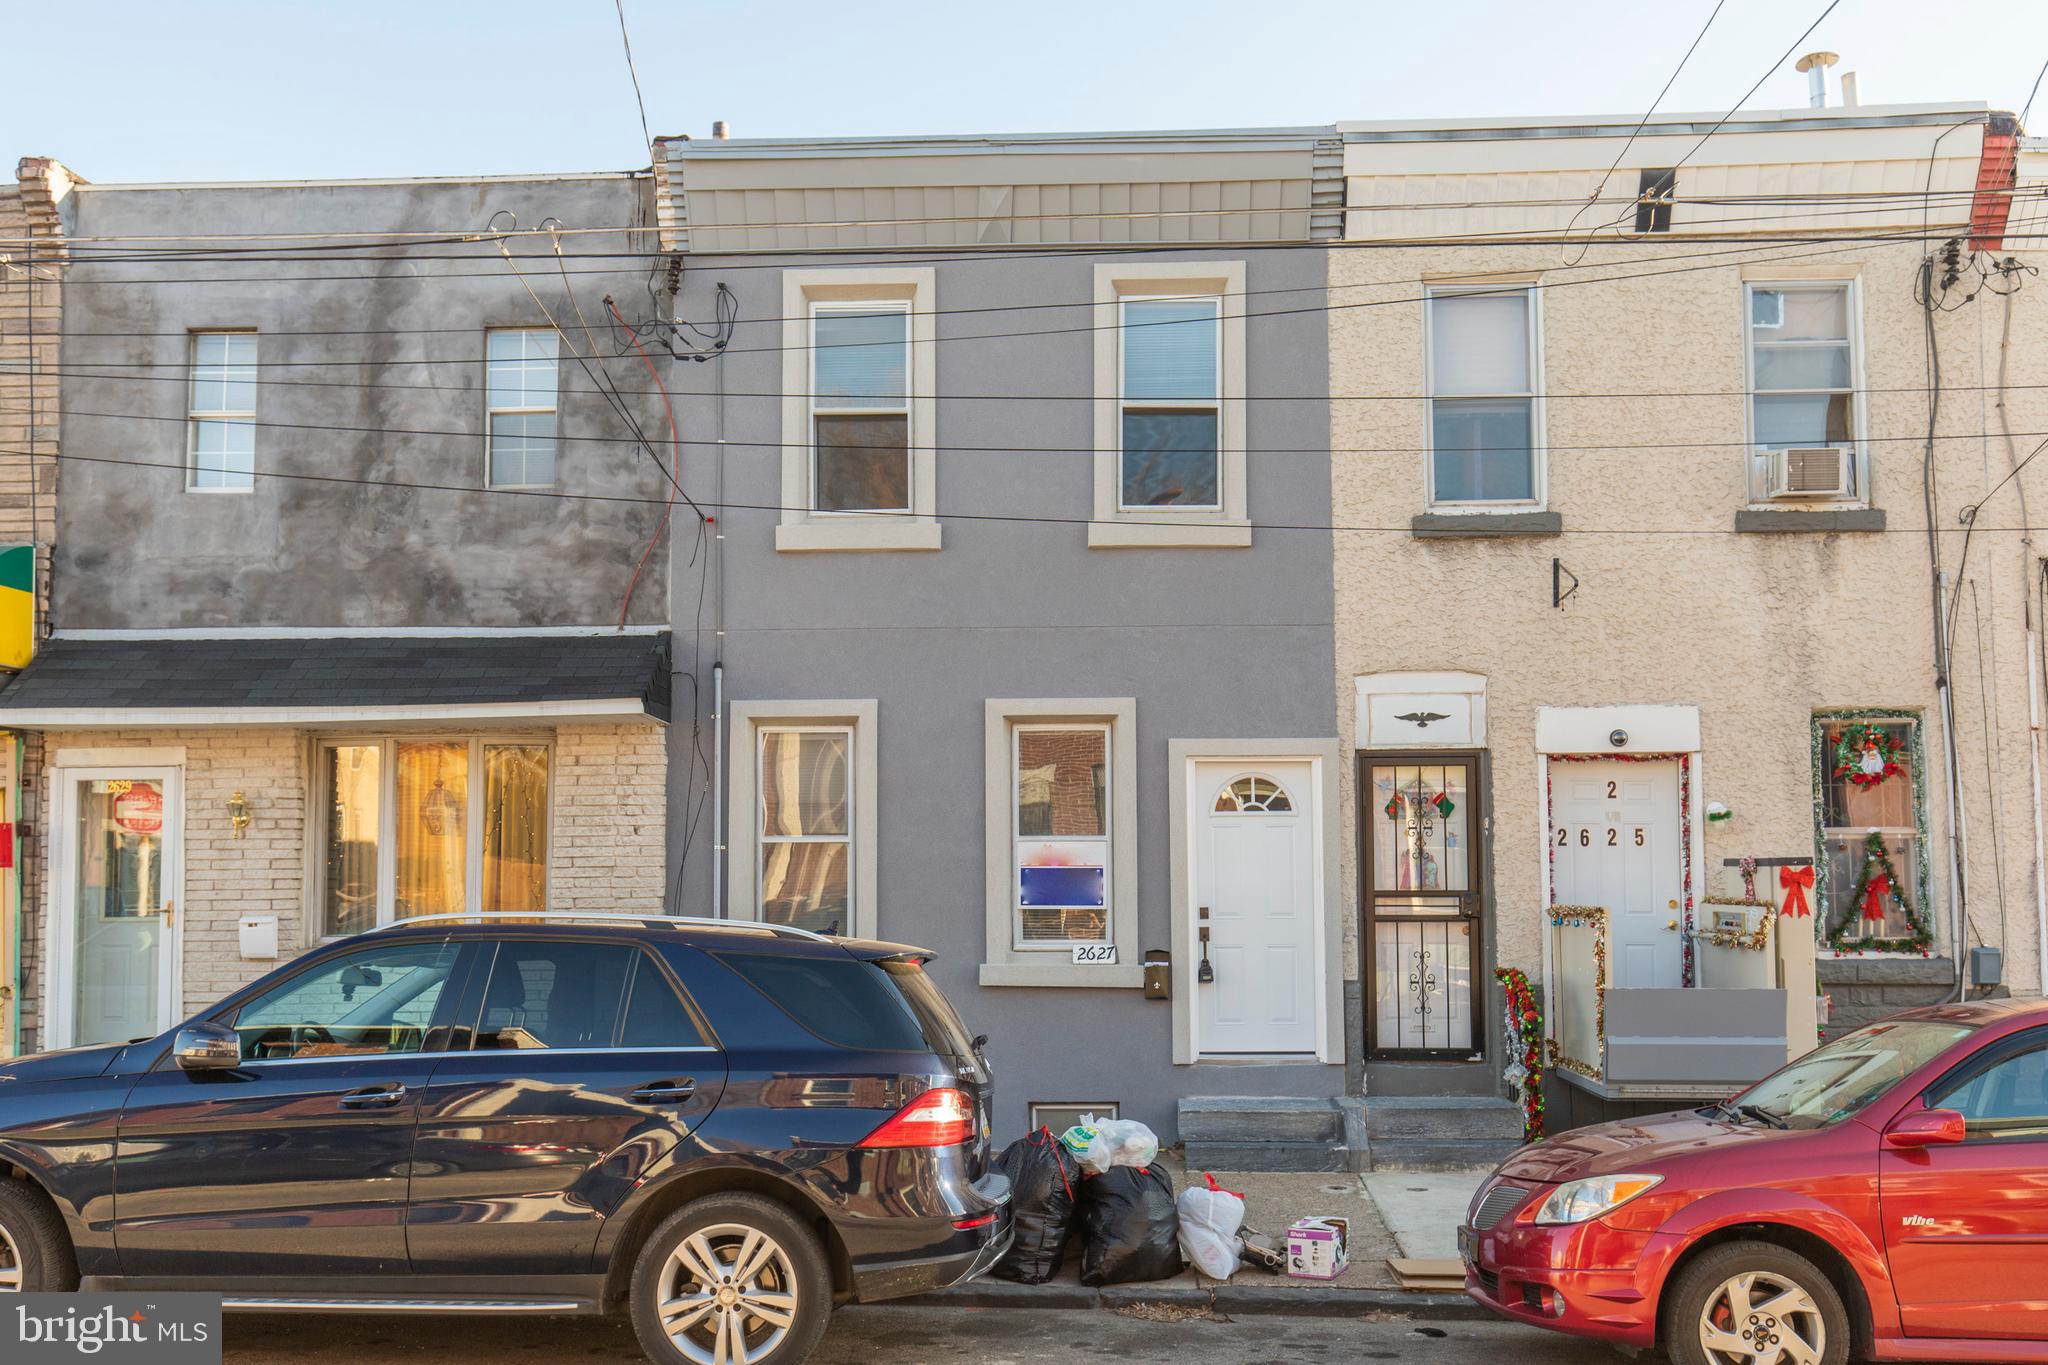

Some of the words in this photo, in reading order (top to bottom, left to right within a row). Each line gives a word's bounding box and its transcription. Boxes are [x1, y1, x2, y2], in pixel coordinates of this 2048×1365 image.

[107, 780, 132, 793] 2629
[1607, 781, 1617, 799] 2
[1077, 946, 1114, 960] 2627
[1902, 1214, 1935, 1226] vibe
